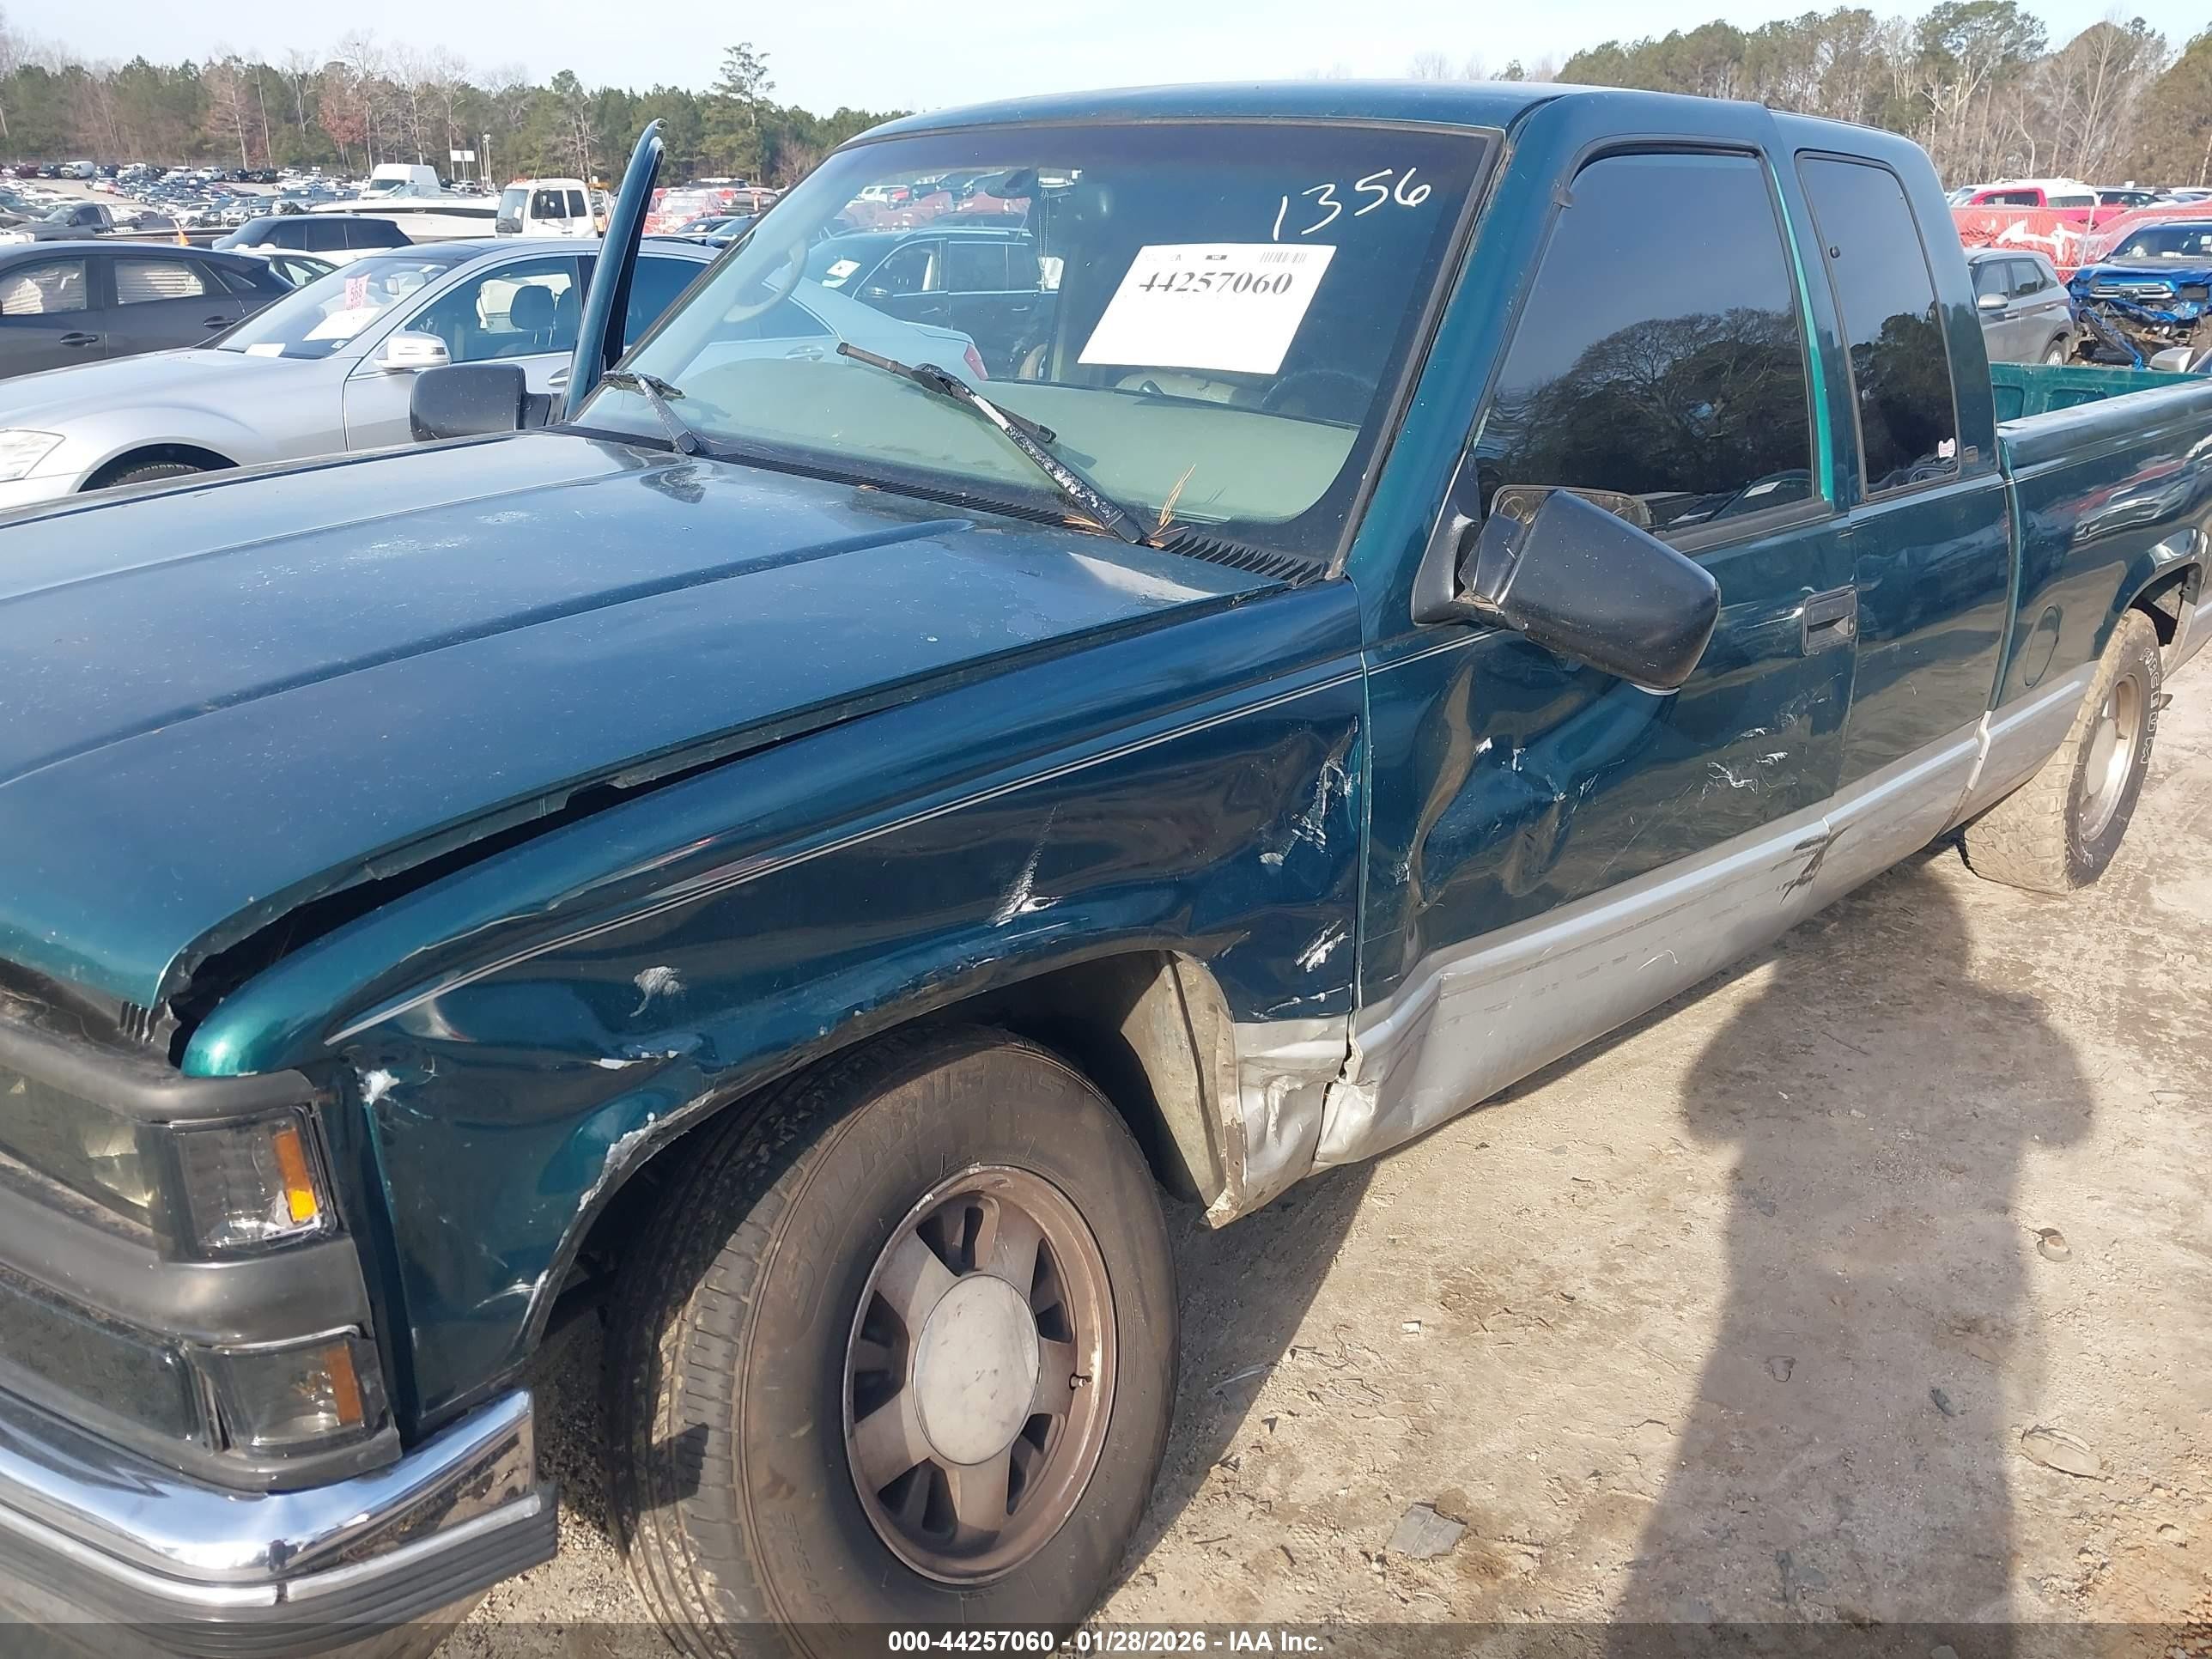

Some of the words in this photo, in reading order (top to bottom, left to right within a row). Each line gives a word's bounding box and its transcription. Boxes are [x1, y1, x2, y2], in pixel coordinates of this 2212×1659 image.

[1273, 167, 1431, 241] 1356
[1139, 271, 1293, 295] 44257060
[2138, 647, 2160, 764] FORCEUM
